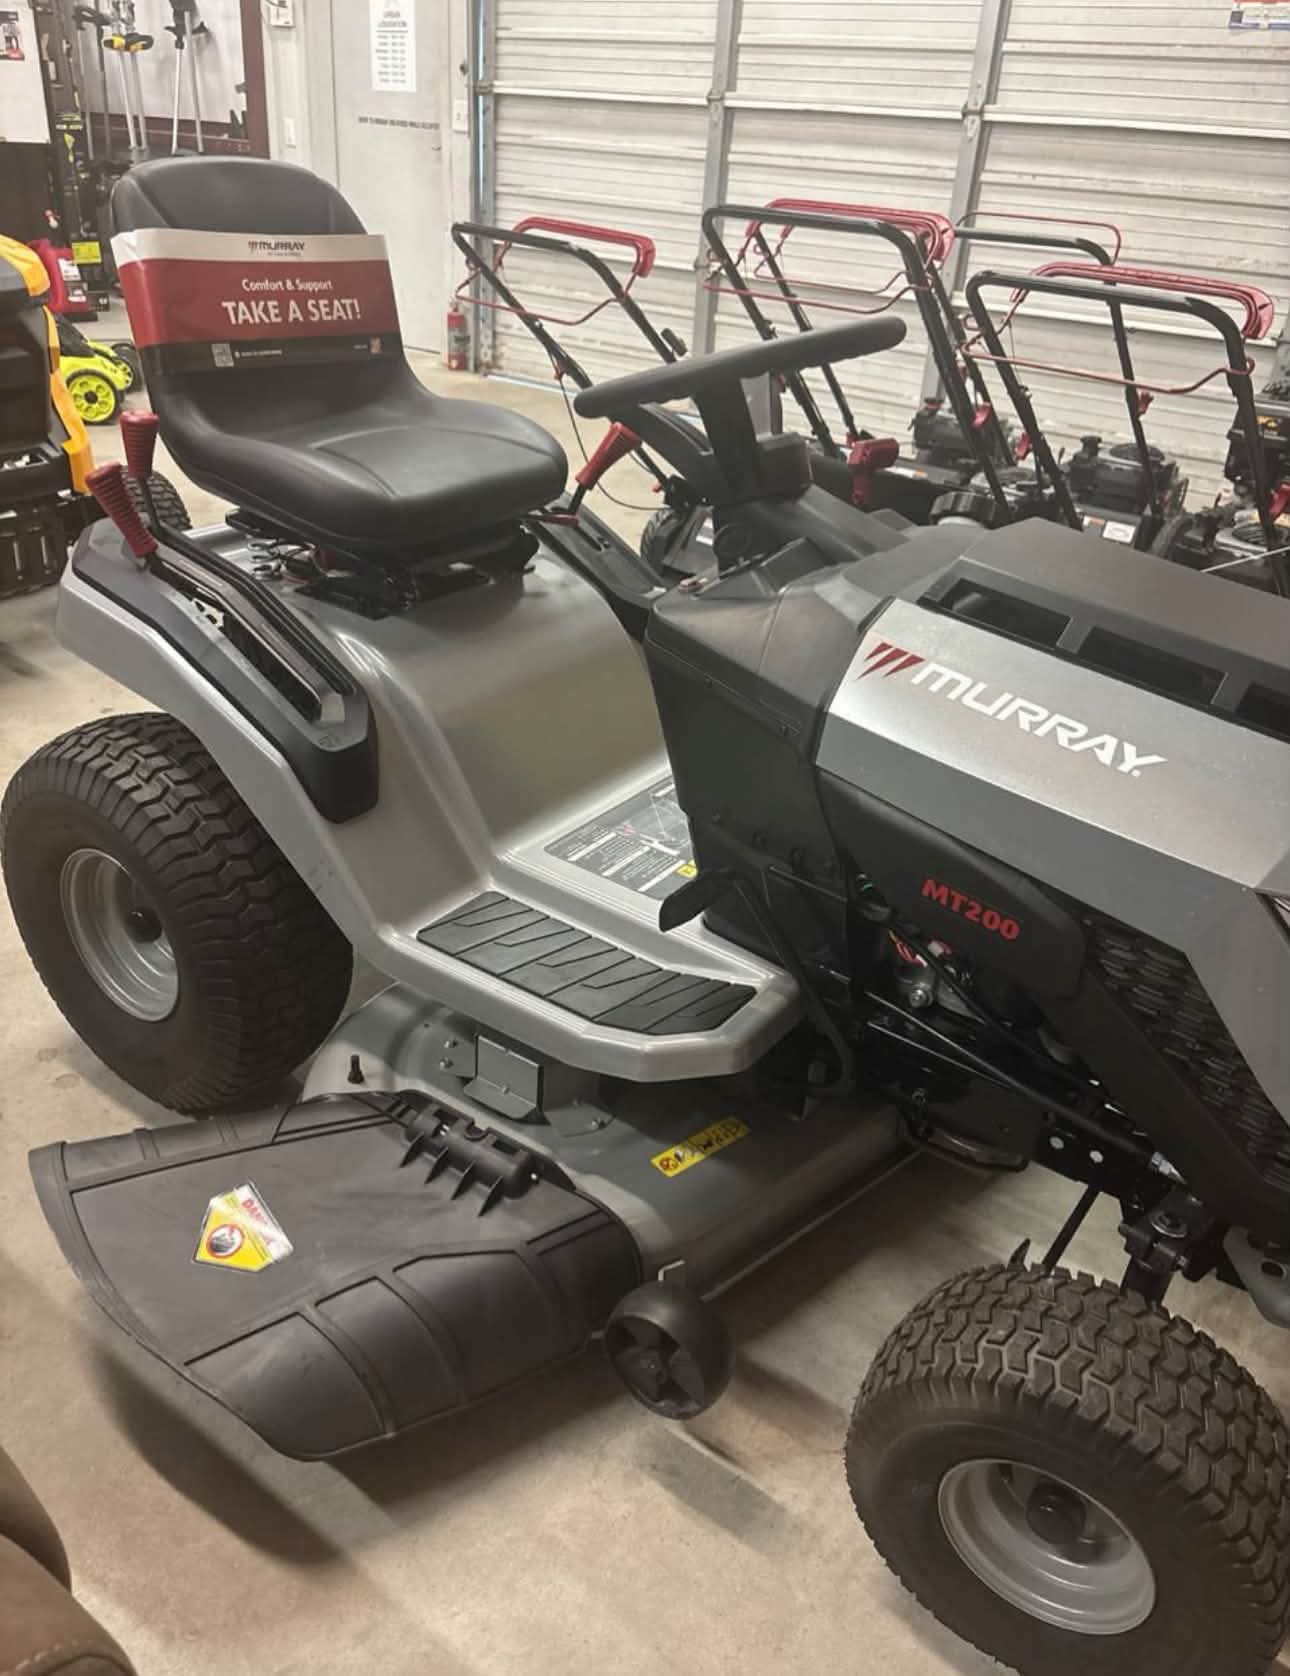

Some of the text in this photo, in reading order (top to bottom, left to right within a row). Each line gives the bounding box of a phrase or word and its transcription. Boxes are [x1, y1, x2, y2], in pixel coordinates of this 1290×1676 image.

[258, 240, 305, 251] MURRAY
[241, 278, 334, 293] Comfort & Support
[221, 298, 362, 326] TAKE A SEAT!
[910, 662, 1168, 777] MURRAY
[920, 878, 1021, 942] MT200
